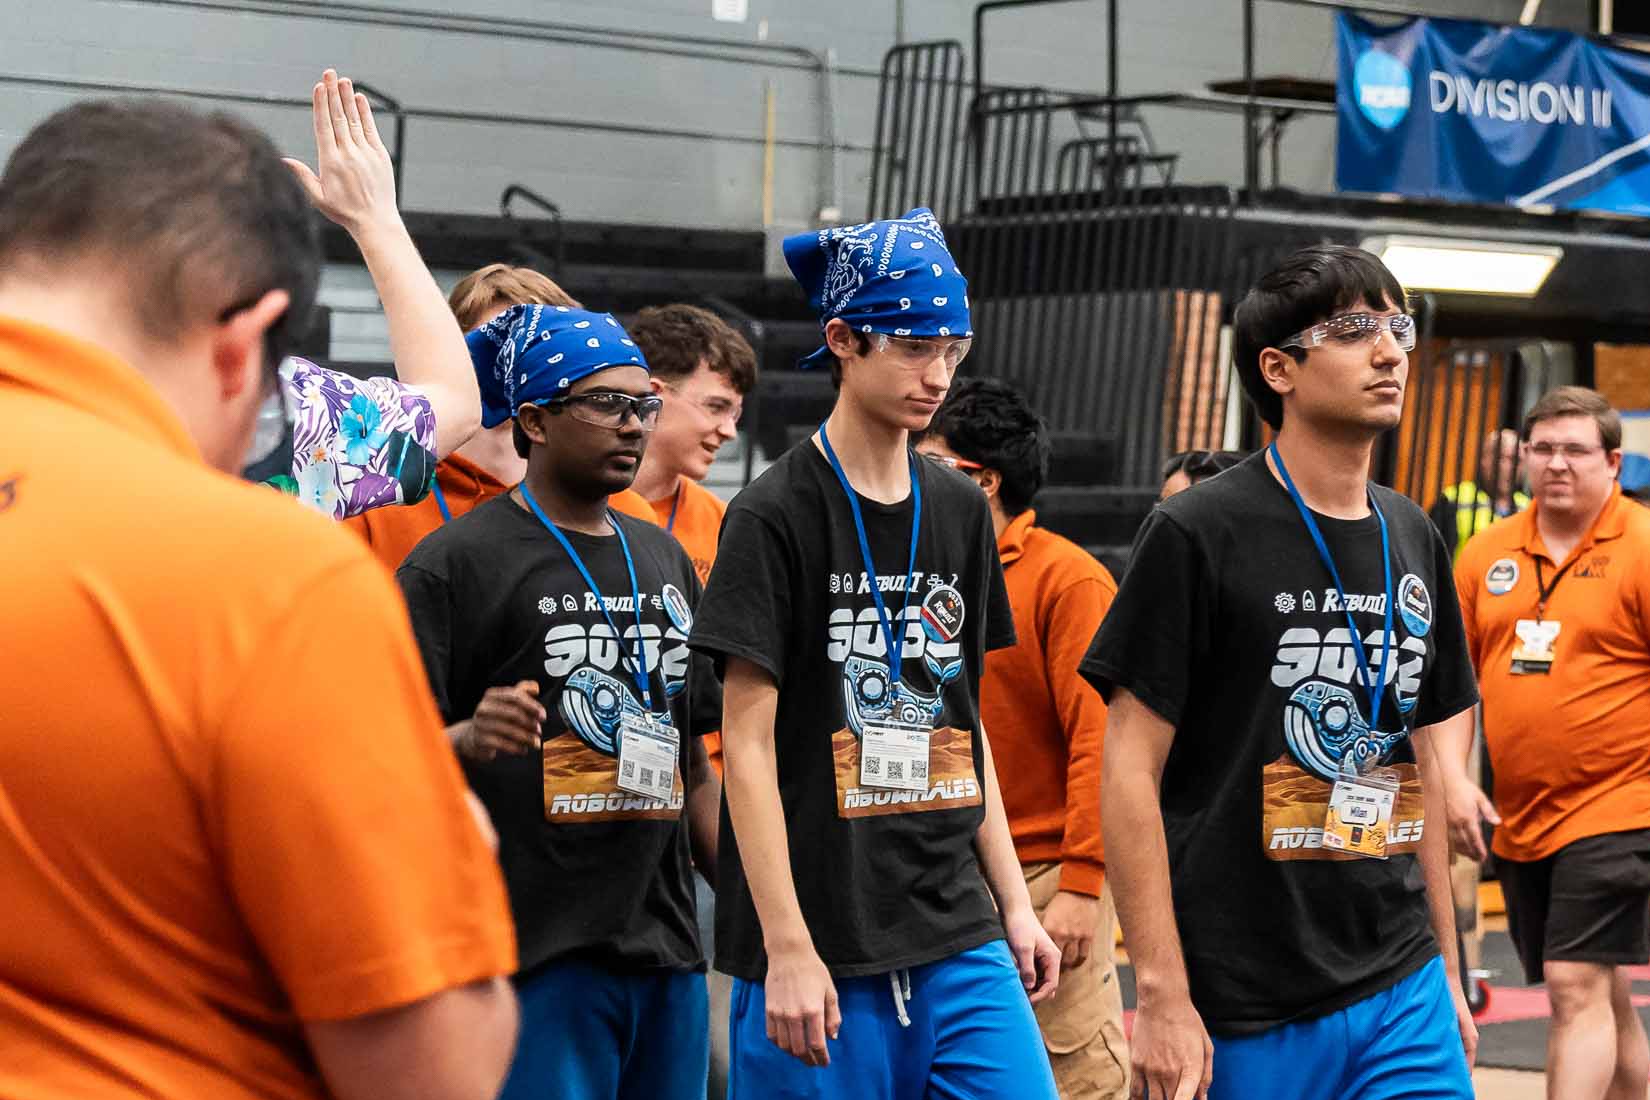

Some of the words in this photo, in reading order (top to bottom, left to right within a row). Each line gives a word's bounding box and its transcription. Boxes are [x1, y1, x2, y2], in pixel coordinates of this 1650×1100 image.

[1429, 70, 1585, 126] DIVISION
[1592, 88, 1612, 129] II
[544, 623, 691, 678] 9032
[1270, 627, 1427, 693] 9032
